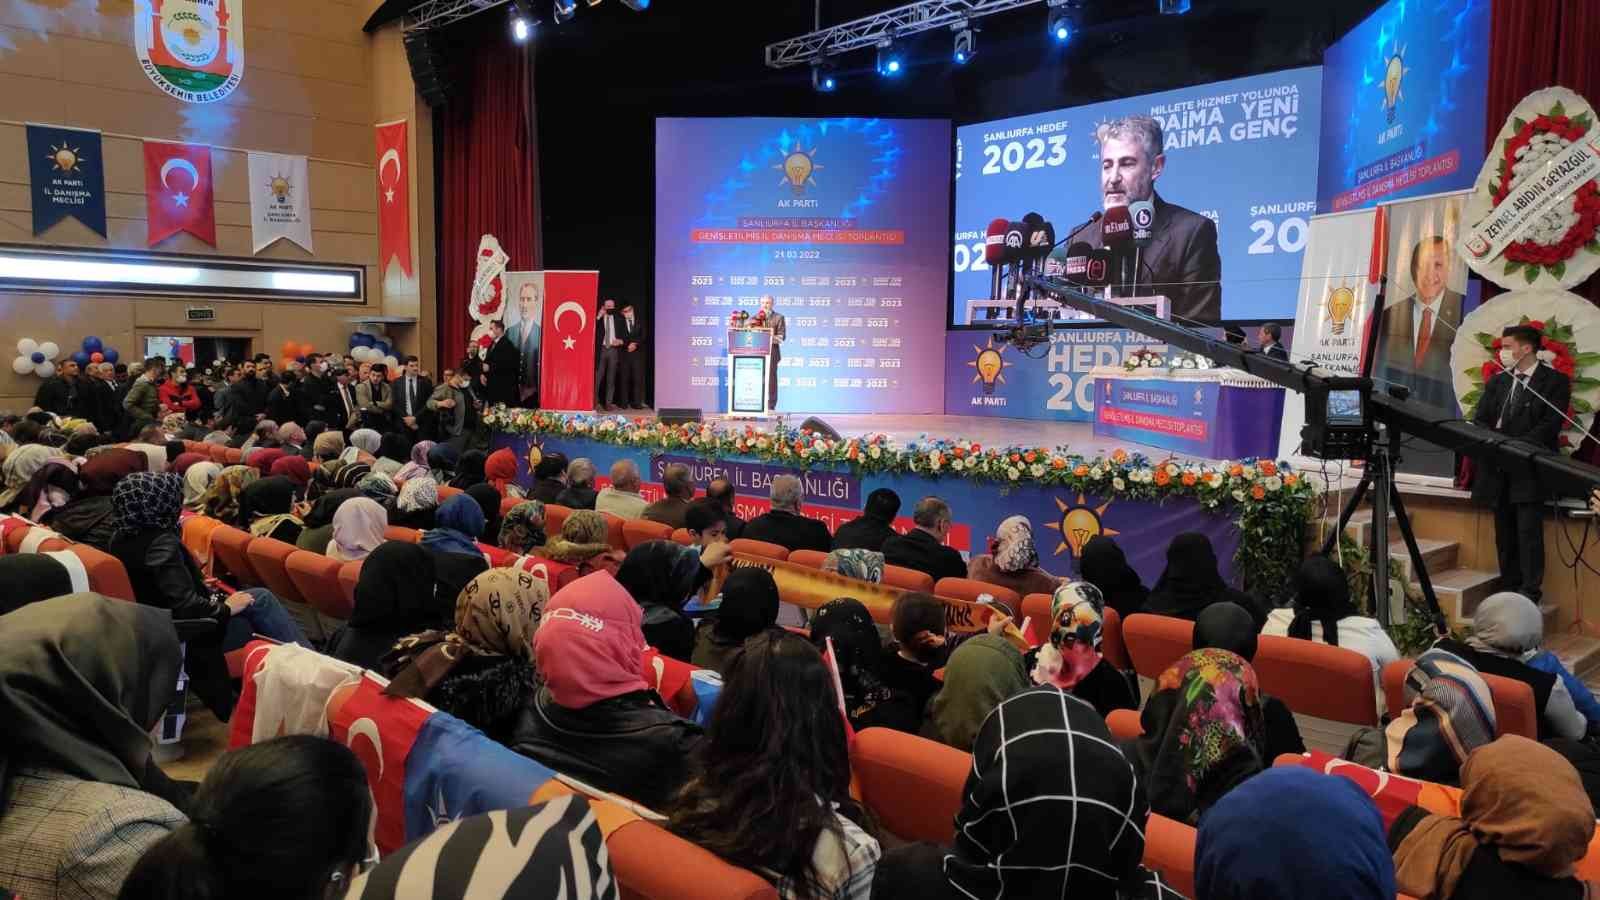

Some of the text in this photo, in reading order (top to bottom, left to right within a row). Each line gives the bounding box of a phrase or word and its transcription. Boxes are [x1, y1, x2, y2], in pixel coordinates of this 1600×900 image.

[1150, 84, 1298, 115] MİLLETE HİZMET YOLUNDA
[1241, 95, 1299, 120] YENİ
[1036, 121, 1068, 134] HEDEF
[1163, 115, 1298, 151] AİMA GENÇ
[982, 135, 1068, 176] 2023
[52, 197, 85, 205] MECLİSİ
[54, 189, 92, 198] DANIŞMA
[777, 199, 818, 208] AK PARTİ
[1248, 217, 1309, 254] 20
[1484, 209, 1517, 240] ZEYNEL
[971, 397, 1007, 406] AK PARTİ
[1046, 373, 1095, 412] 20
[735, 466, 748, 488] İL
